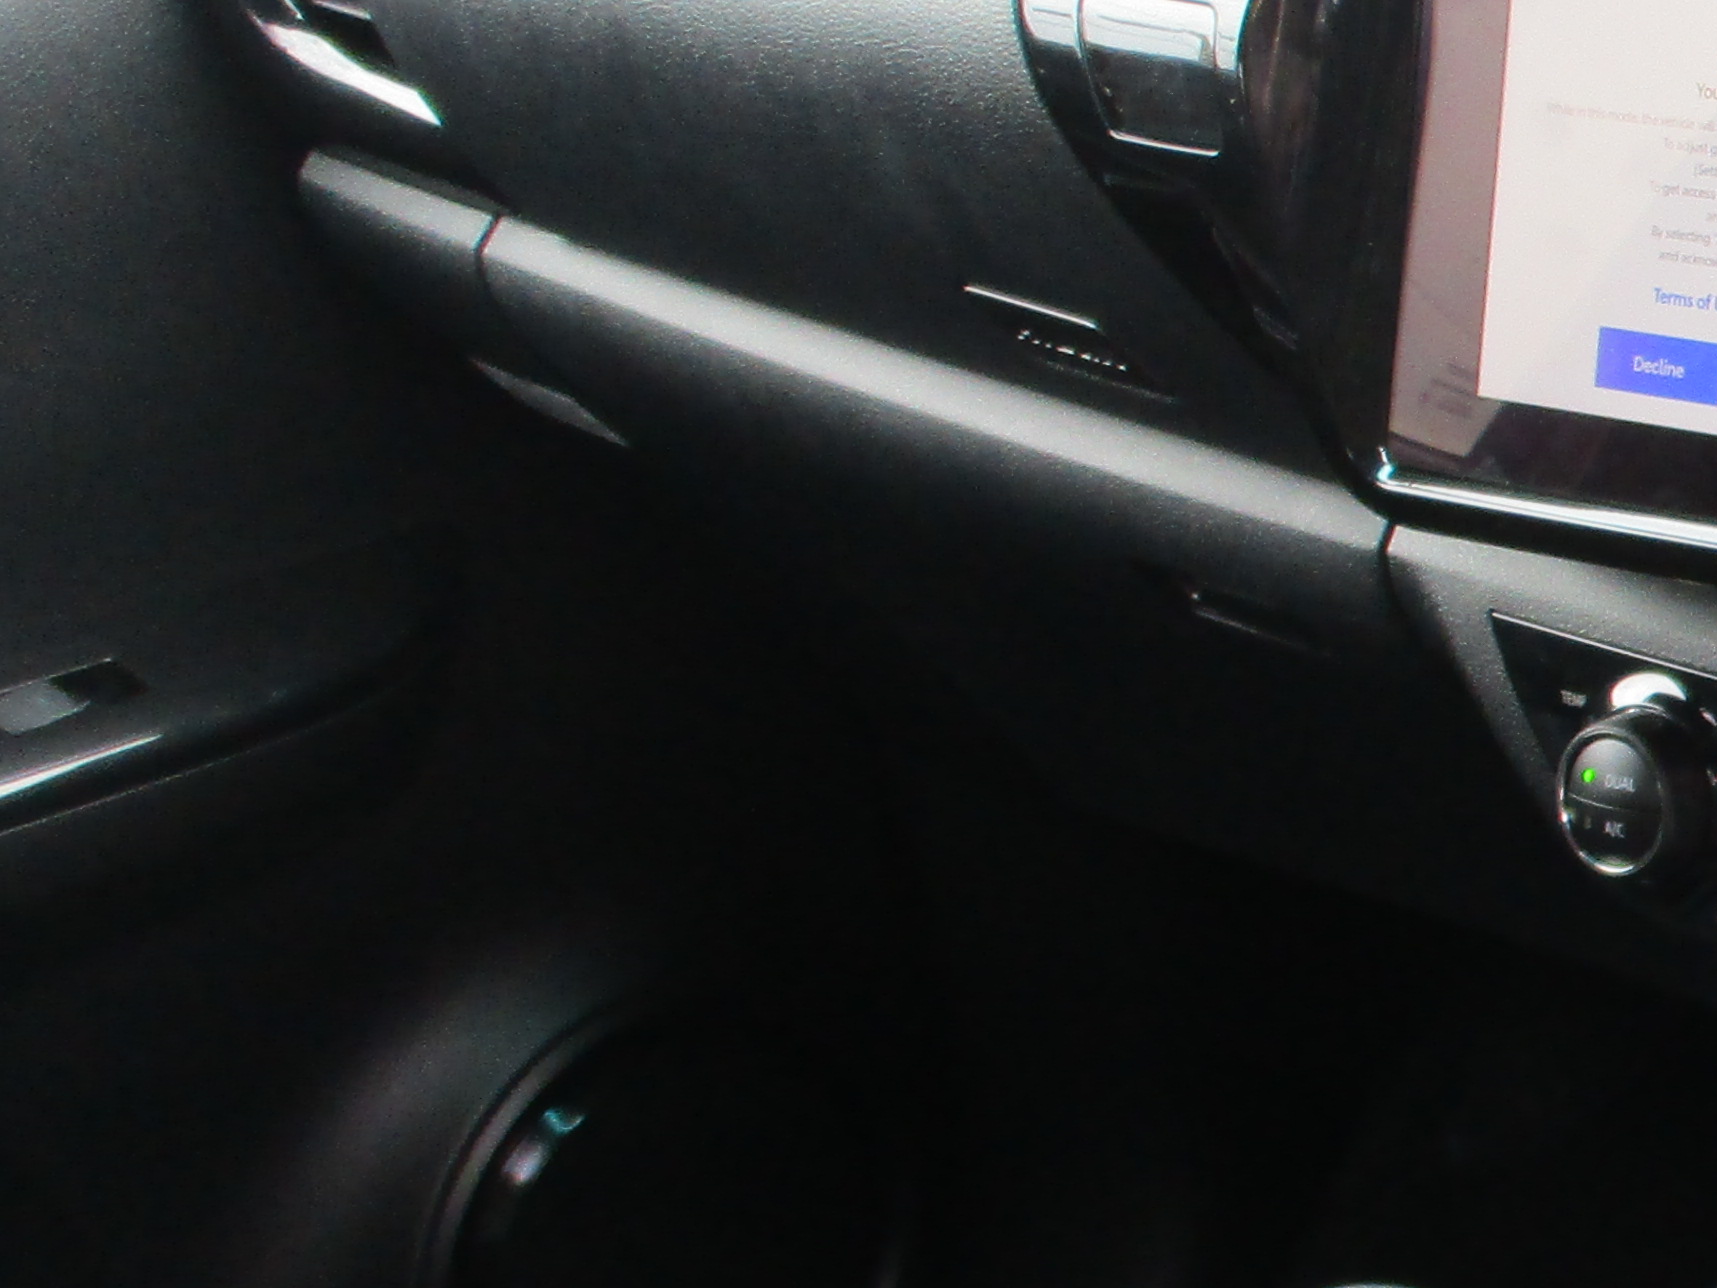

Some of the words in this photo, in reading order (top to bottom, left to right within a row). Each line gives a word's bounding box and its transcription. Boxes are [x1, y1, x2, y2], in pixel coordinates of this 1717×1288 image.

[1664, 136, 1674, 149] To
[1676, 140, 1708, 155] adjust
[1662, 184, 1680, 197] get
[1681, 186, 1716, 201] access
[1651, 224, 1664, 240] By
[1665, 228, 1712, 247] selecting
[1657, 250, 1679, 262] and
[1652, 287, 1694, 309] Terms
[1695, 293, 1711, 312] of
[1632, 354, 1685, 380] Decline
[1604, 773, 1636, 793] DUAL
